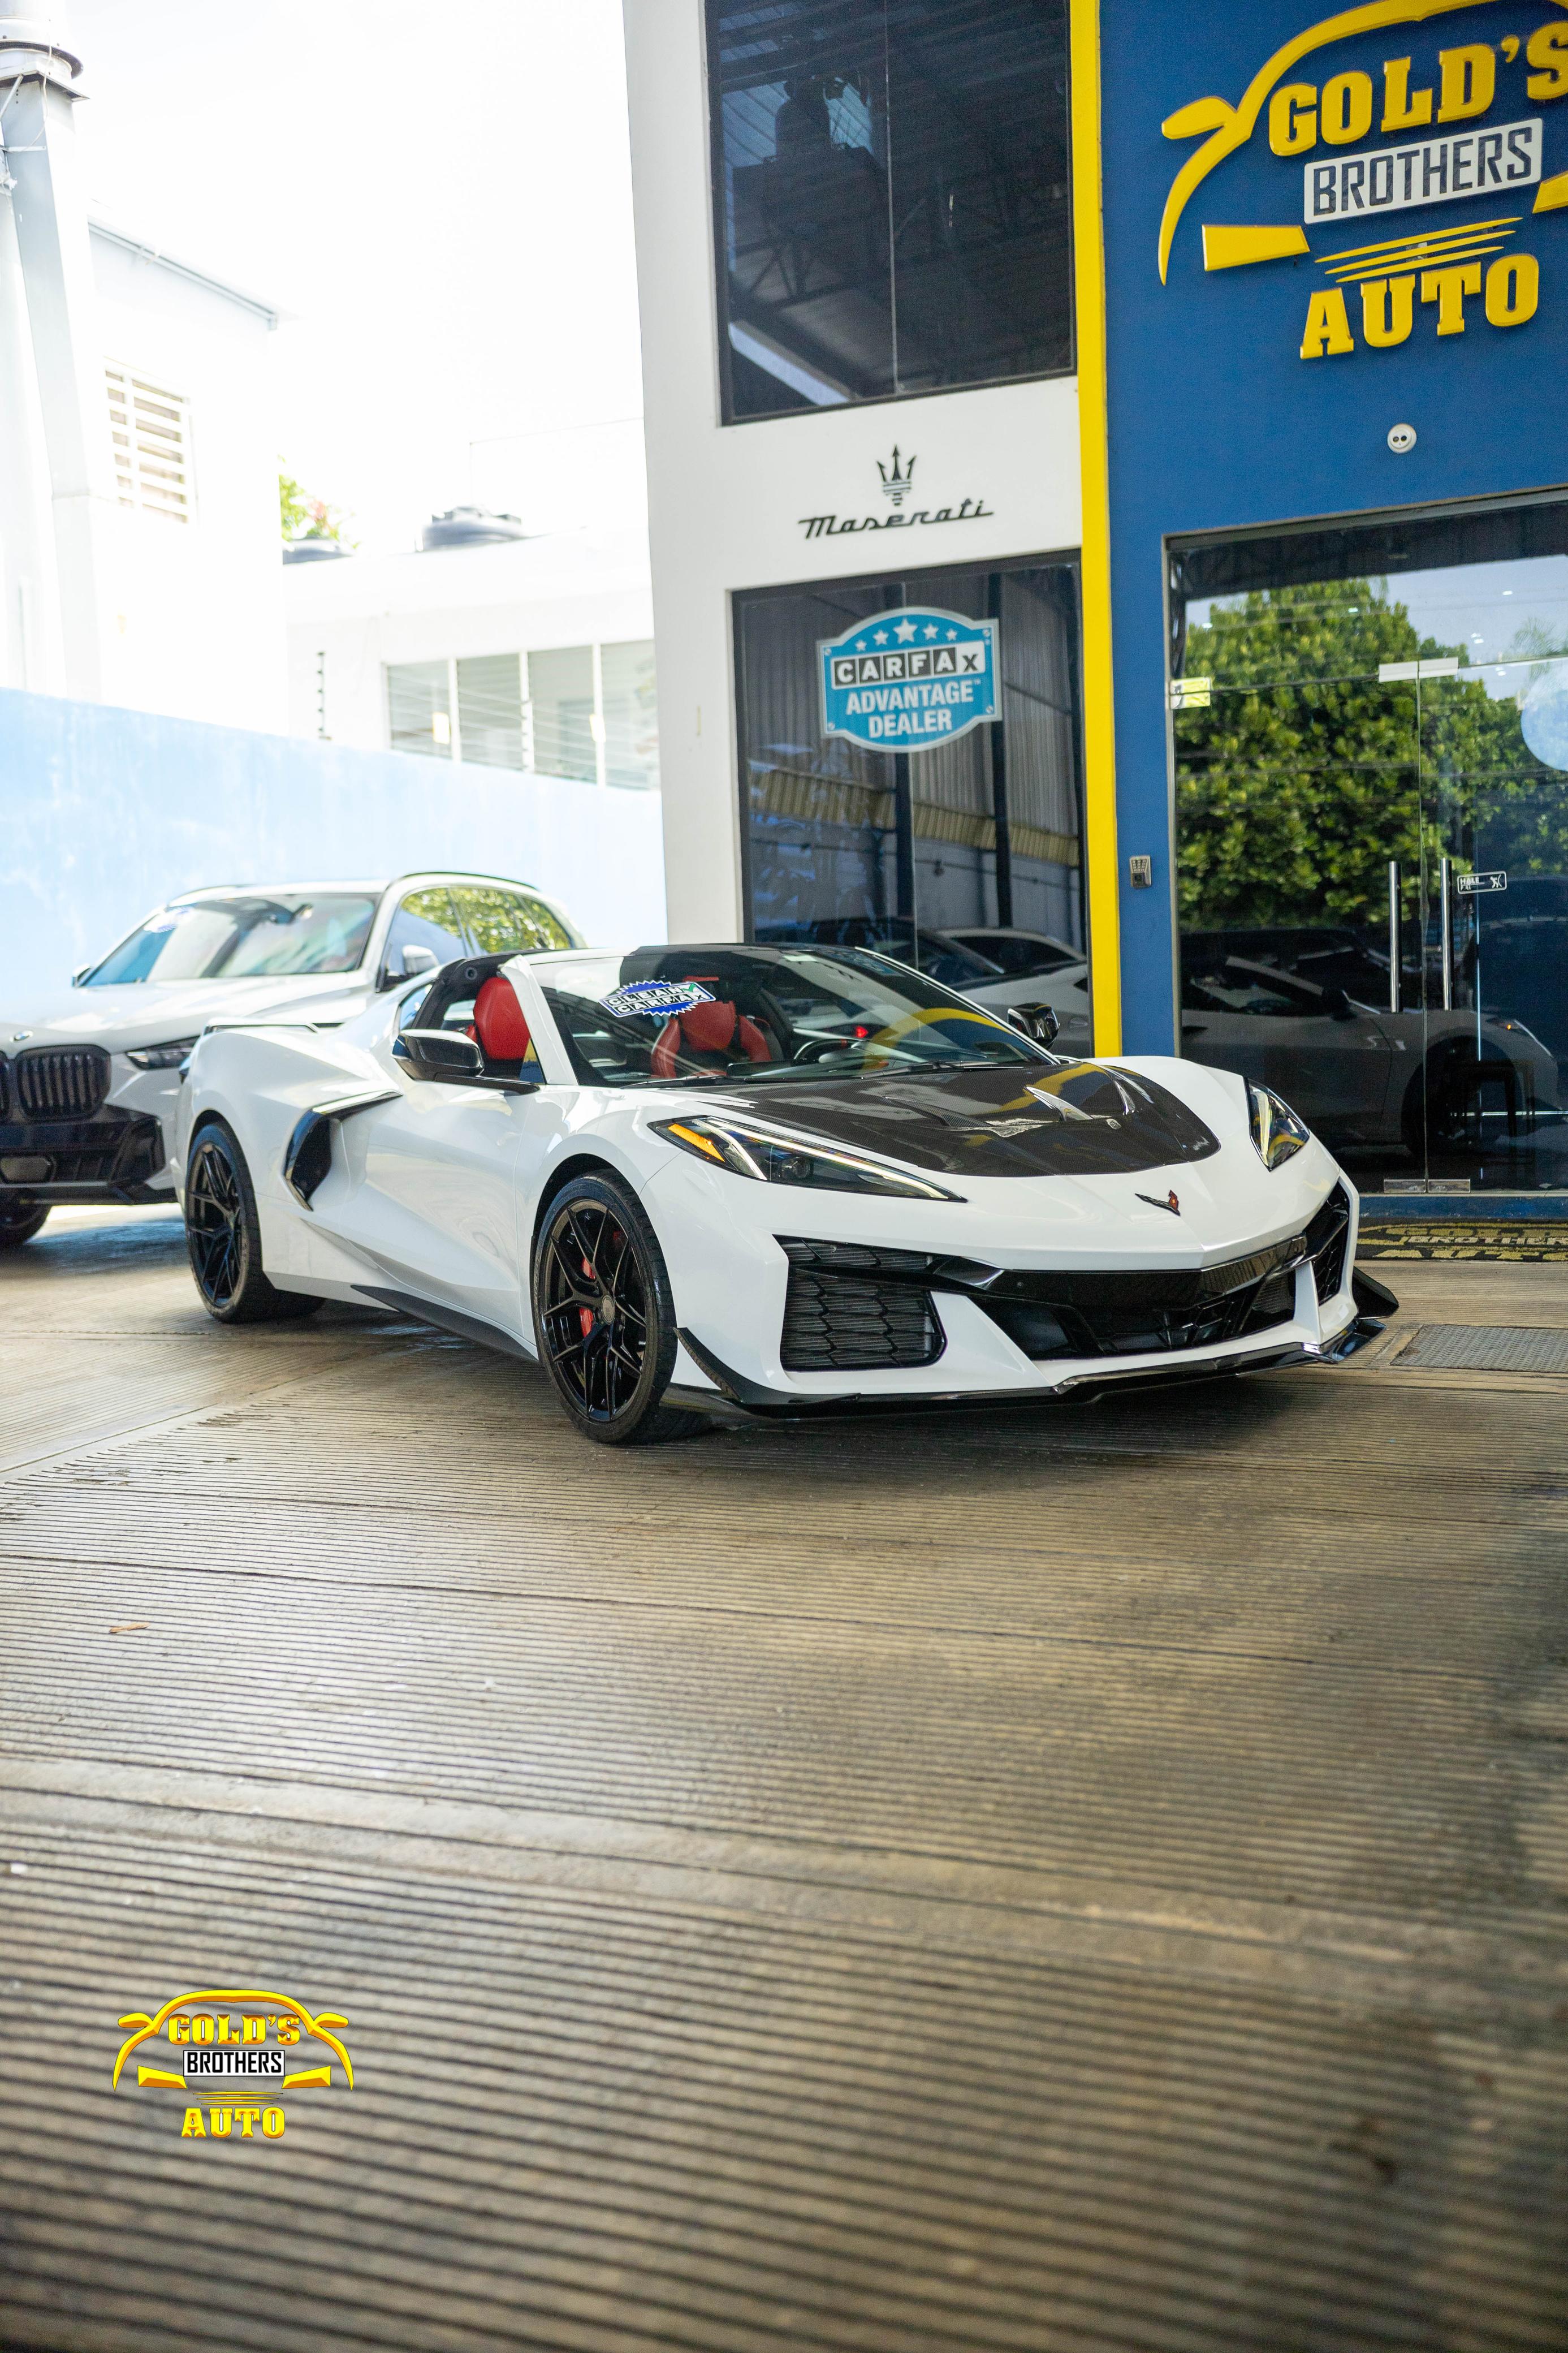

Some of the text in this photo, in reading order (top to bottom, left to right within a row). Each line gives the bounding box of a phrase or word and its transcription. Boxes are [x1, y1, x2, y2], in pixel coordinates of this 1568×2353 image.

[1269, 20, 1568, 157] GOLD'S
[1313, 126, 1532, 217] BROTHERS
[1300, 253, 1539, 359] AUTO
[798, 498, 994, 539] Maserati
[836, 650, 978, 683] CARFAX
[868, 708, 952, 738] DEALER
[607, 987, 684, 1006] CLEAN
[617, 994, 709, 1013] CARFAX
